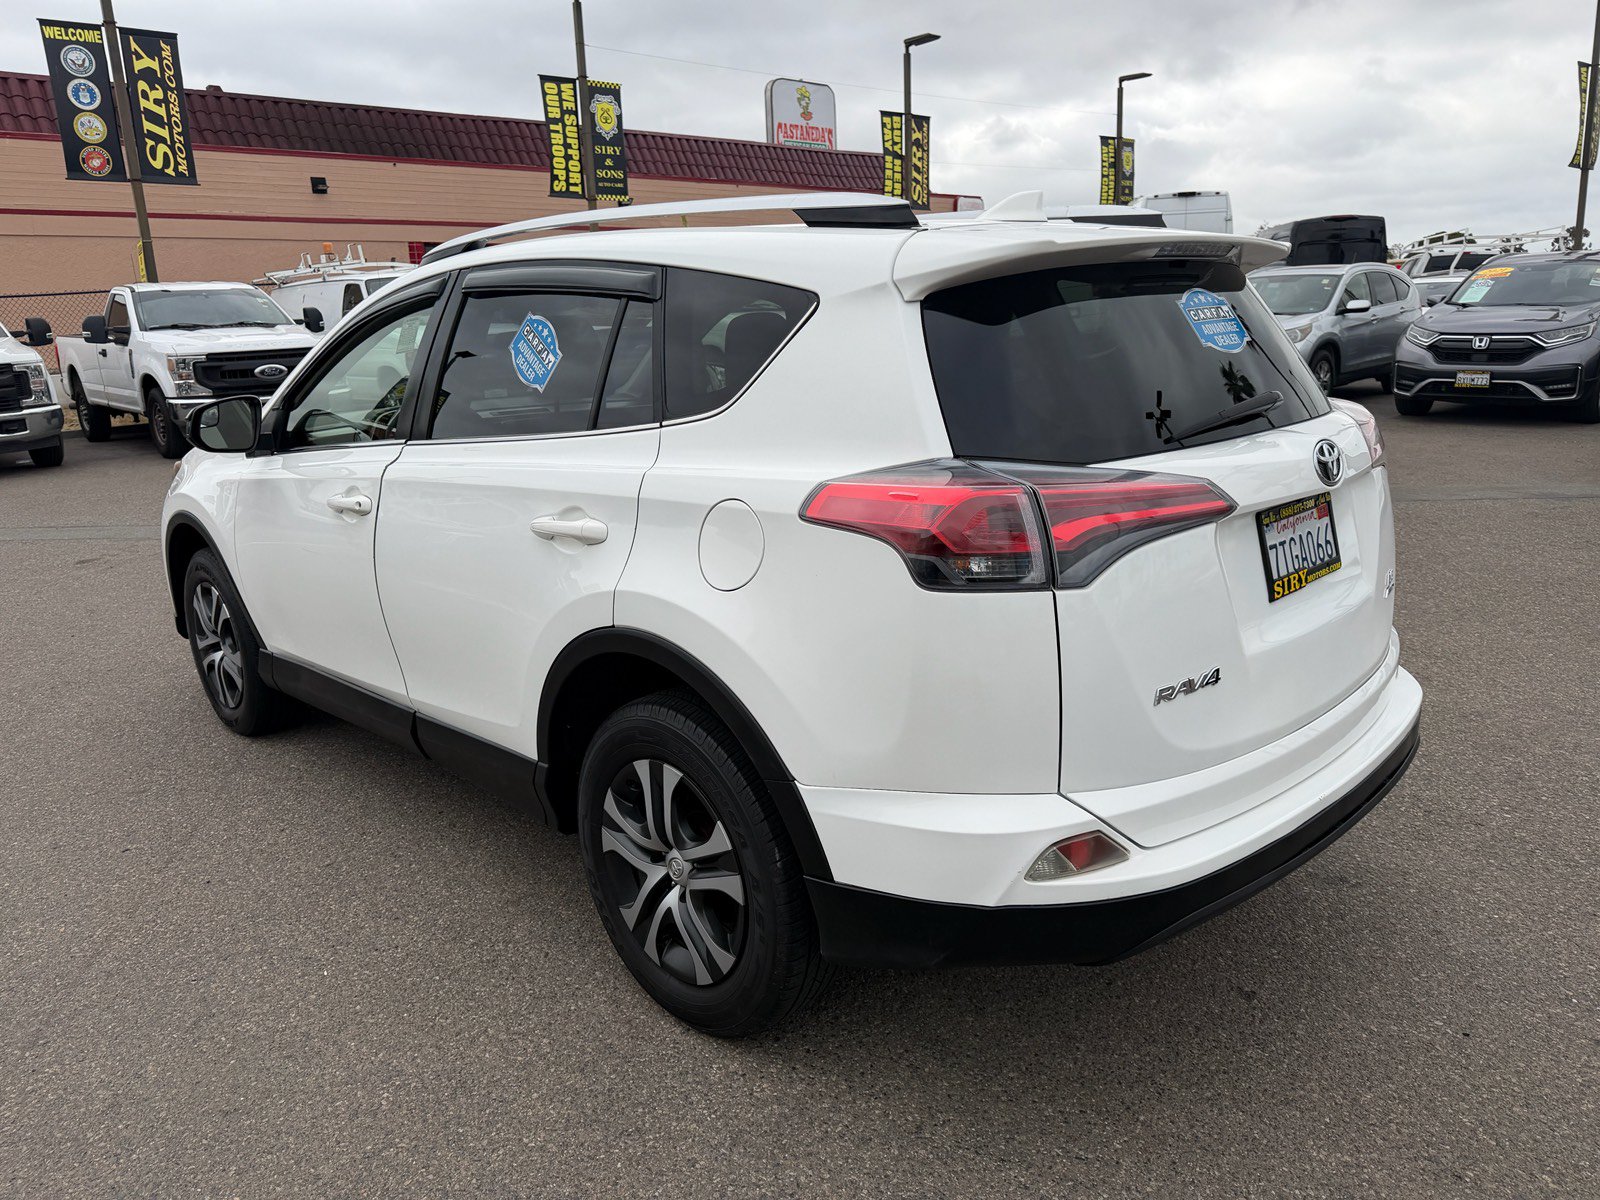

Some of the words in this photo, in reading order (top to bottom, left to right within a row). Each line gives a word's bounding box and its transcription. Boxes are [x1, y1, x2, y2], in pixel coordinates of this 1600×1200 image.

[42, 25, 103, 43] WELCOME
[129, 35, 176, 177] SIRY
[544, 82, 561, 119] OUR
[560, 83, 576, 111] WE
[594, 145, 621, 155] SIRY
[882, 116, 893, 152] PAY
[892, 116, 902, 155] BUY
[549, 122, 567, 192] TROOPS
[564, 115, 582, 194] SUPPORT
[604, 157, 614, 166] &
[911, 119, 923, 205] SIRY
[596, 169, 624, 179] SONS
[1190, 306, 1235, 320] CARFAX
[1201, 321, 1240, 335] ADVANTAGE
[523, 325, 555, 370] CARFAX
[1214, 333, 1241, 346] DEALER
[516, 354, 535, 382] DEALER
[517, 340, 546, 377] ADVANTAGE
[1276, 510, 1318, 534] California
[1269, 522, 1334, 579] 7TGA066
[1273, 568, 1308, 600] SIRY
[1306, 561, 1342, 583] MOTORS.COM
[1153, 665, 1222, 706] RAV4
